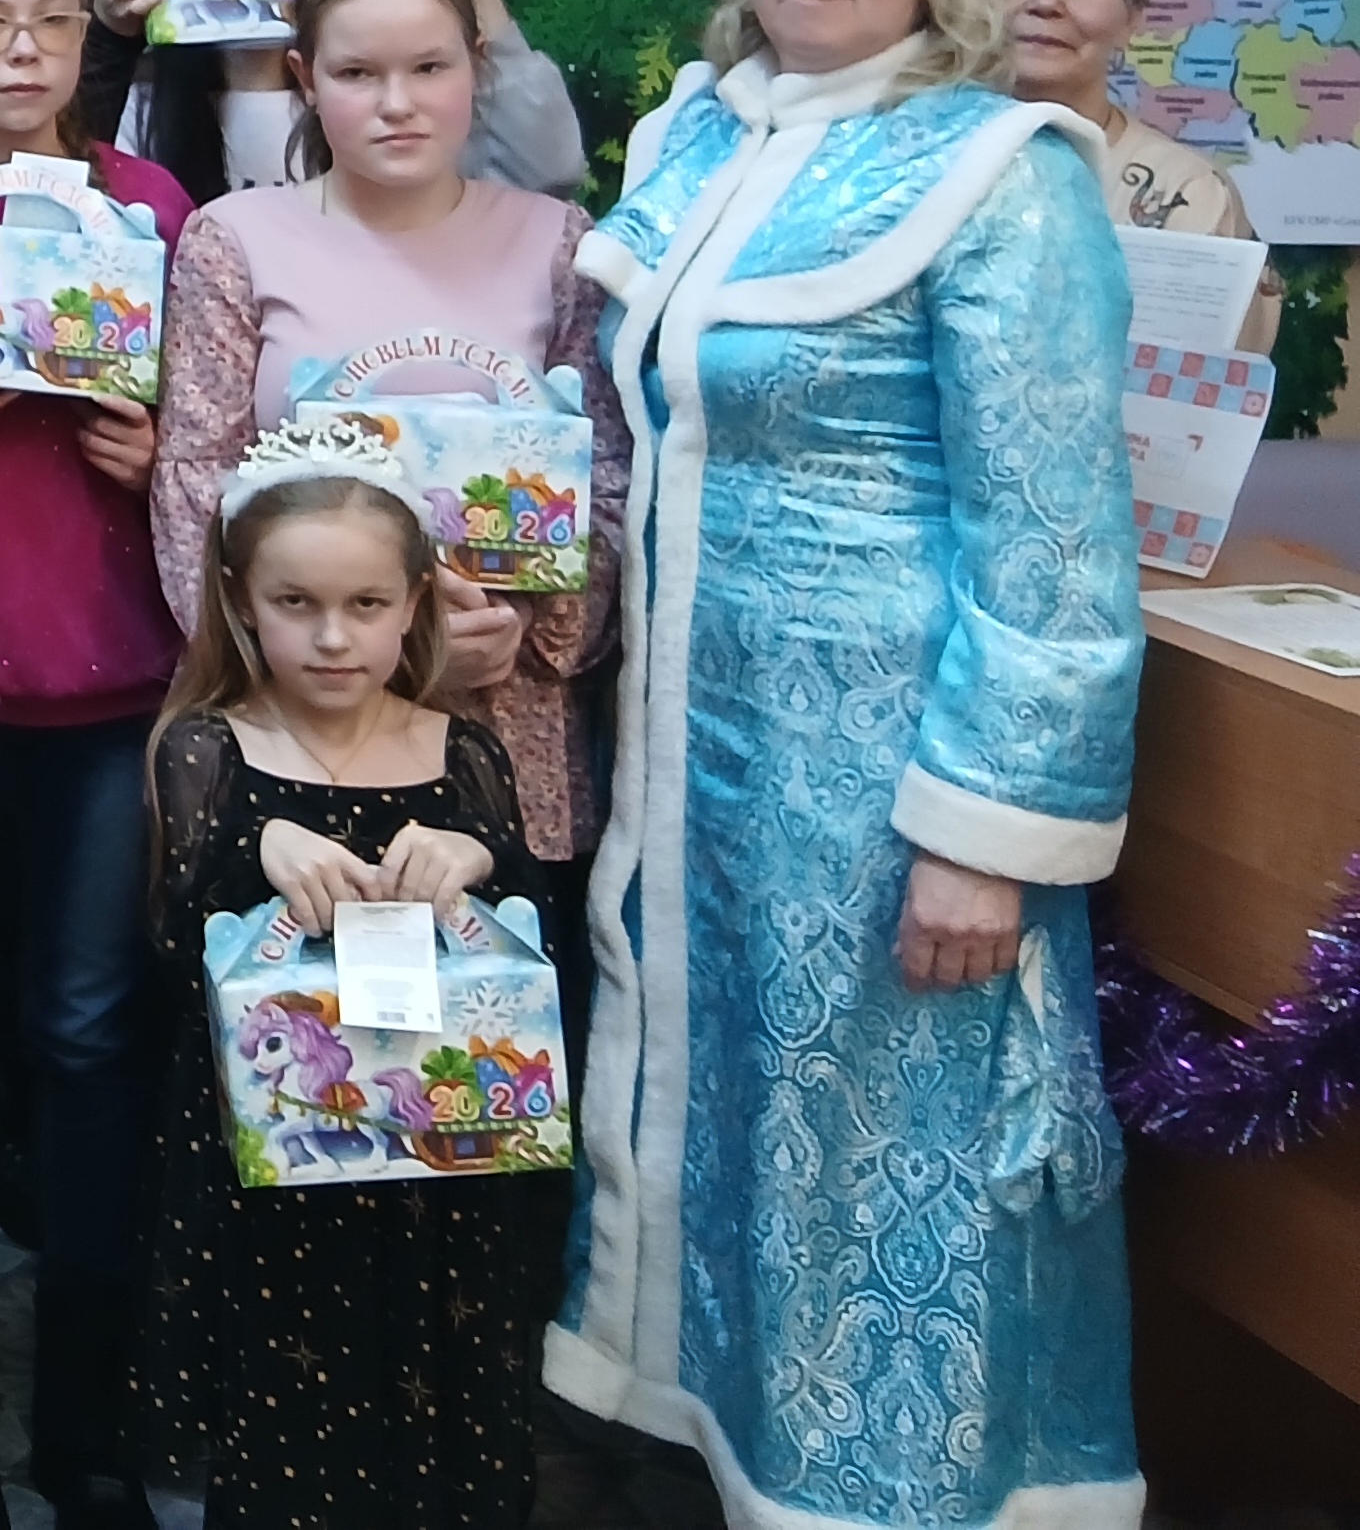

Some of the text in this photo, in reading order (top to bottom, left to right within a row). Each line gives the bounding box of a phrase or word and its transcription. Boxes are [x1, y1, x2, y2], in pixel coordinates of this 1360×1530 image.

[52, 316, 148, 355] 2026
[333, 379, 355, 399] С
[345, 336, 440, 382] НОВЫМ
[463, 507, 572, 545] 2026
[259, 942, 286, 961] С
[428, 1081, 553, 1124] 2026
